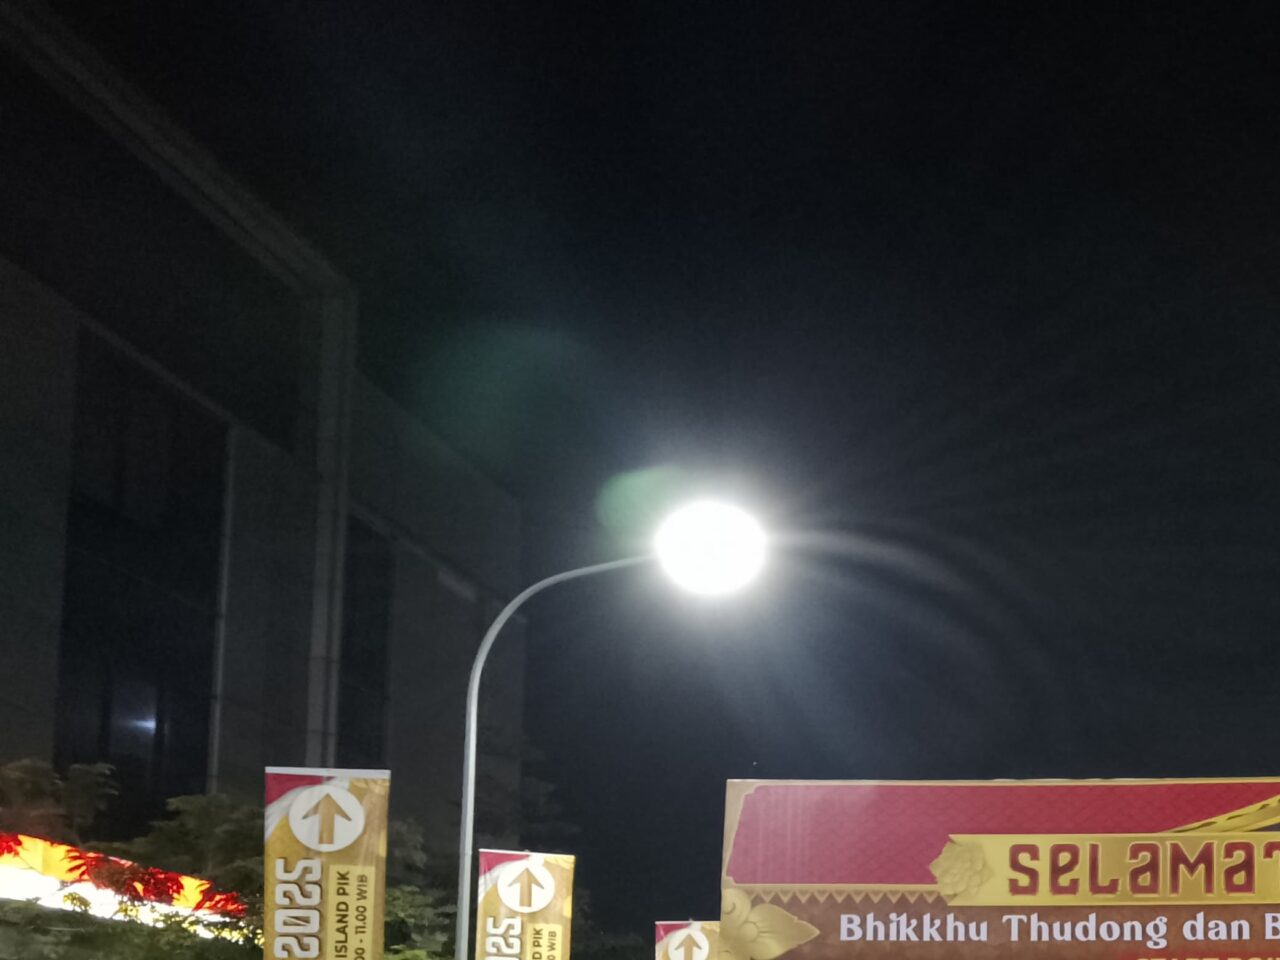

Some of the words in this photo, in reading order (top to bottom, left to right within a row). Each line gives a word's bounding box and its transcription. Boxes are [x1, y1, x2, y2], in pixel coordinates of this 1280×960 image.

[337, 871, 350, 896] PIK
[356, 874, 368, 901] WIB
[273, 858, 322, 959] 2025
[355, 905, 367, 935] 11.00
[335, 901, 349, 958] ISLAND
[533, 928, 543, 948] PIK
[548, 931, 557, 952] WIB
[839, 912, 988, 942] Bhikkhu
[1002, 911, 1168, 949] Thudong
[1182, 911, 1250, 941] dan
